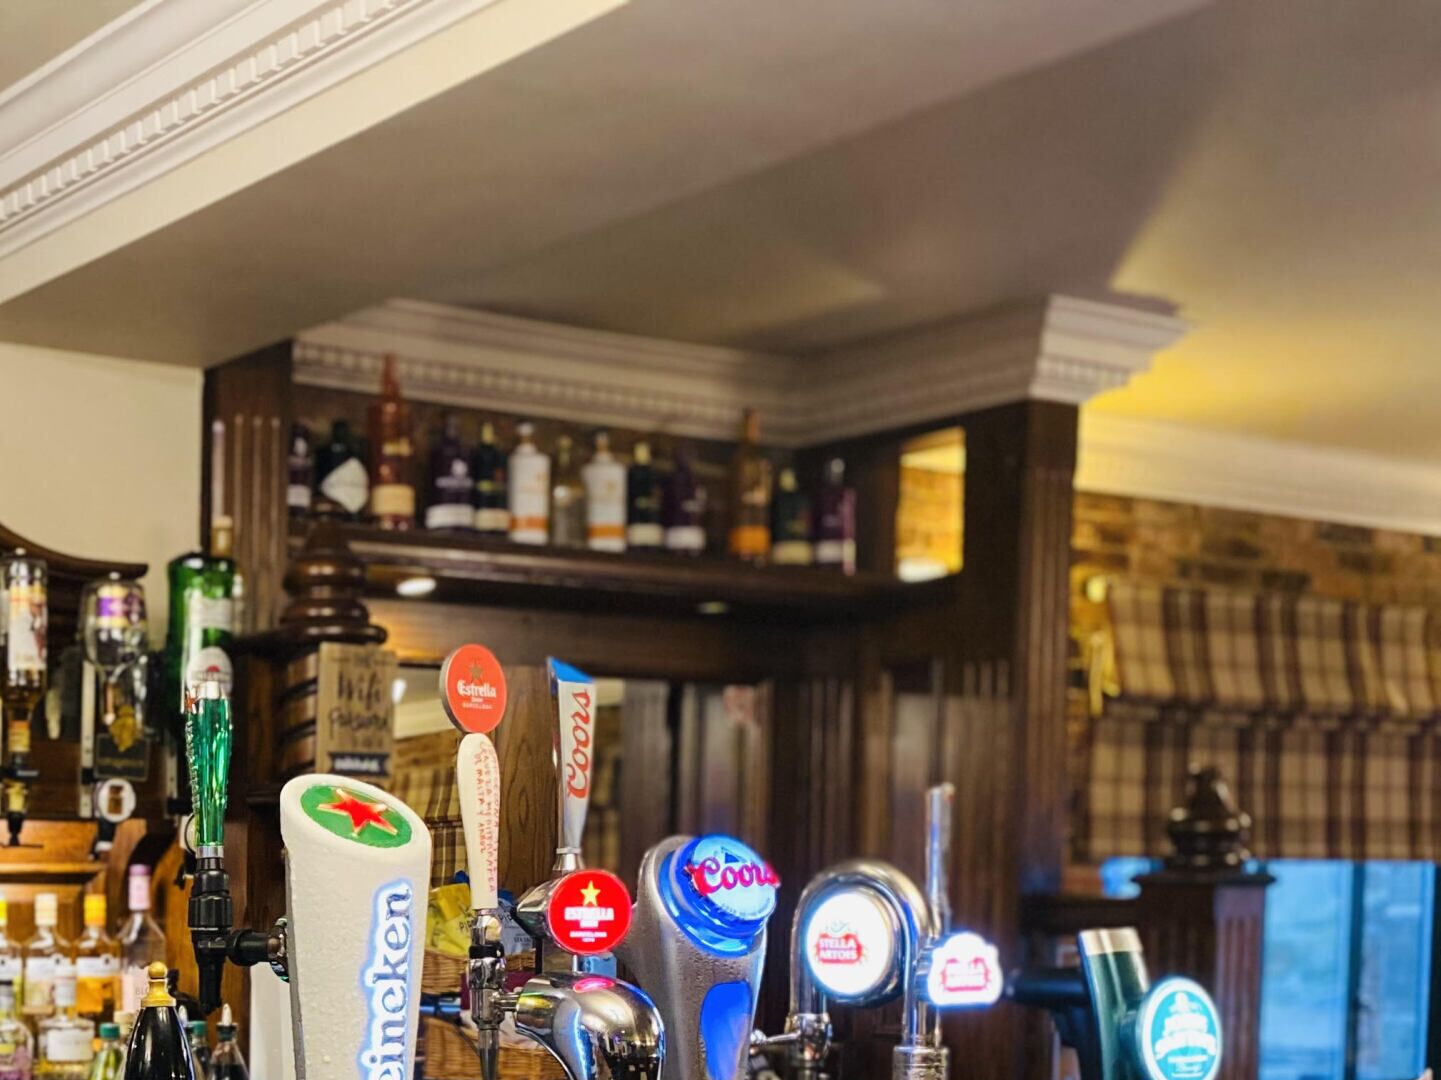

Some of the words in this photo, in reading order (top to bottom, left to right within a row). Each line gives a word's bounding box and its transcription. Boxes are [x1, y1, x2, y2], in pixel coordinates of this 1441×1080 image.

[456, 679, 497, 698] Estrella
[566, 688, 592, 799] Coors
[683, 856, 781, 897] Coors
[819, 938, 857, 949] STELLA
